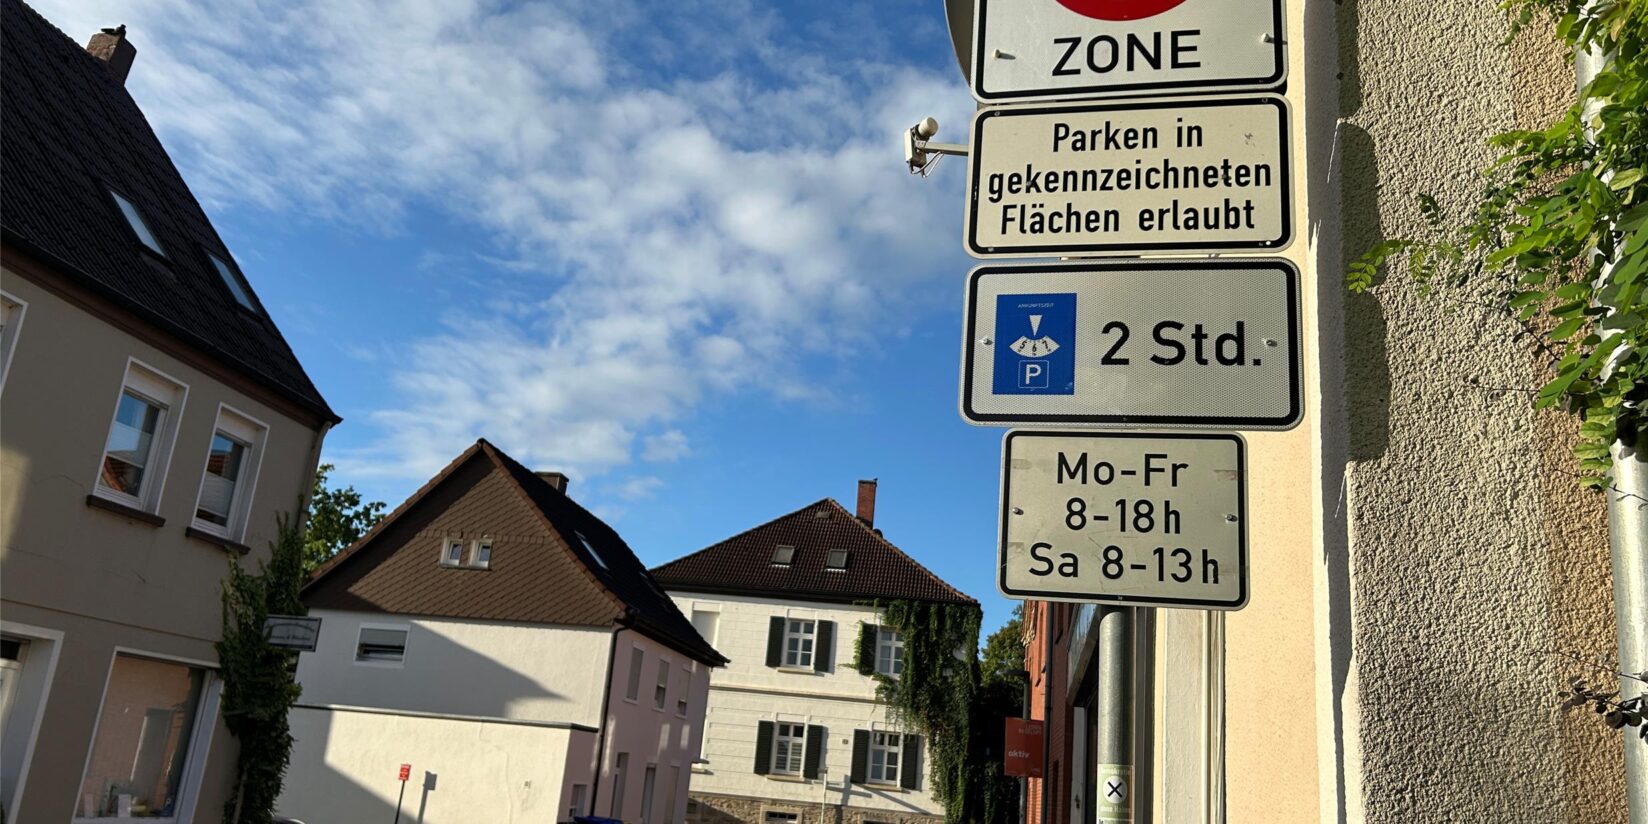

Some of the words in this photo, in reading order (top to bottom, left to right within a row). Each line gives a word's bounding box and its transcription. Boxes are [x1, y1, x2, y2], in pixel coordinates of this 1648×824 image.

[1052, 29, 1201, 77] ZONE
[1053, 120, 1158, 153] Parken
[1176, 117, 1203, 148] in
[988, 158, 1272, 204] gekennzeichneten
[1001, 202, 1120, 235] Flächen
[1138, 198, 1255, 231] erlaubt
[1019, 340, 1027, 349] 5
[1032, 344, 1037, 352] 6
[1042, 340, 1048, 349] 7
[1100, 320, 1131, 366] 2
[1149, 320, 1262, 367] Std.
[1025, 364, 1042, 385] P
[1057, 451, 1189, 488] Mo-Fr
[1028, 542, 1079, 578] Sa
[1008, 749, 1030, 758] aktiv
